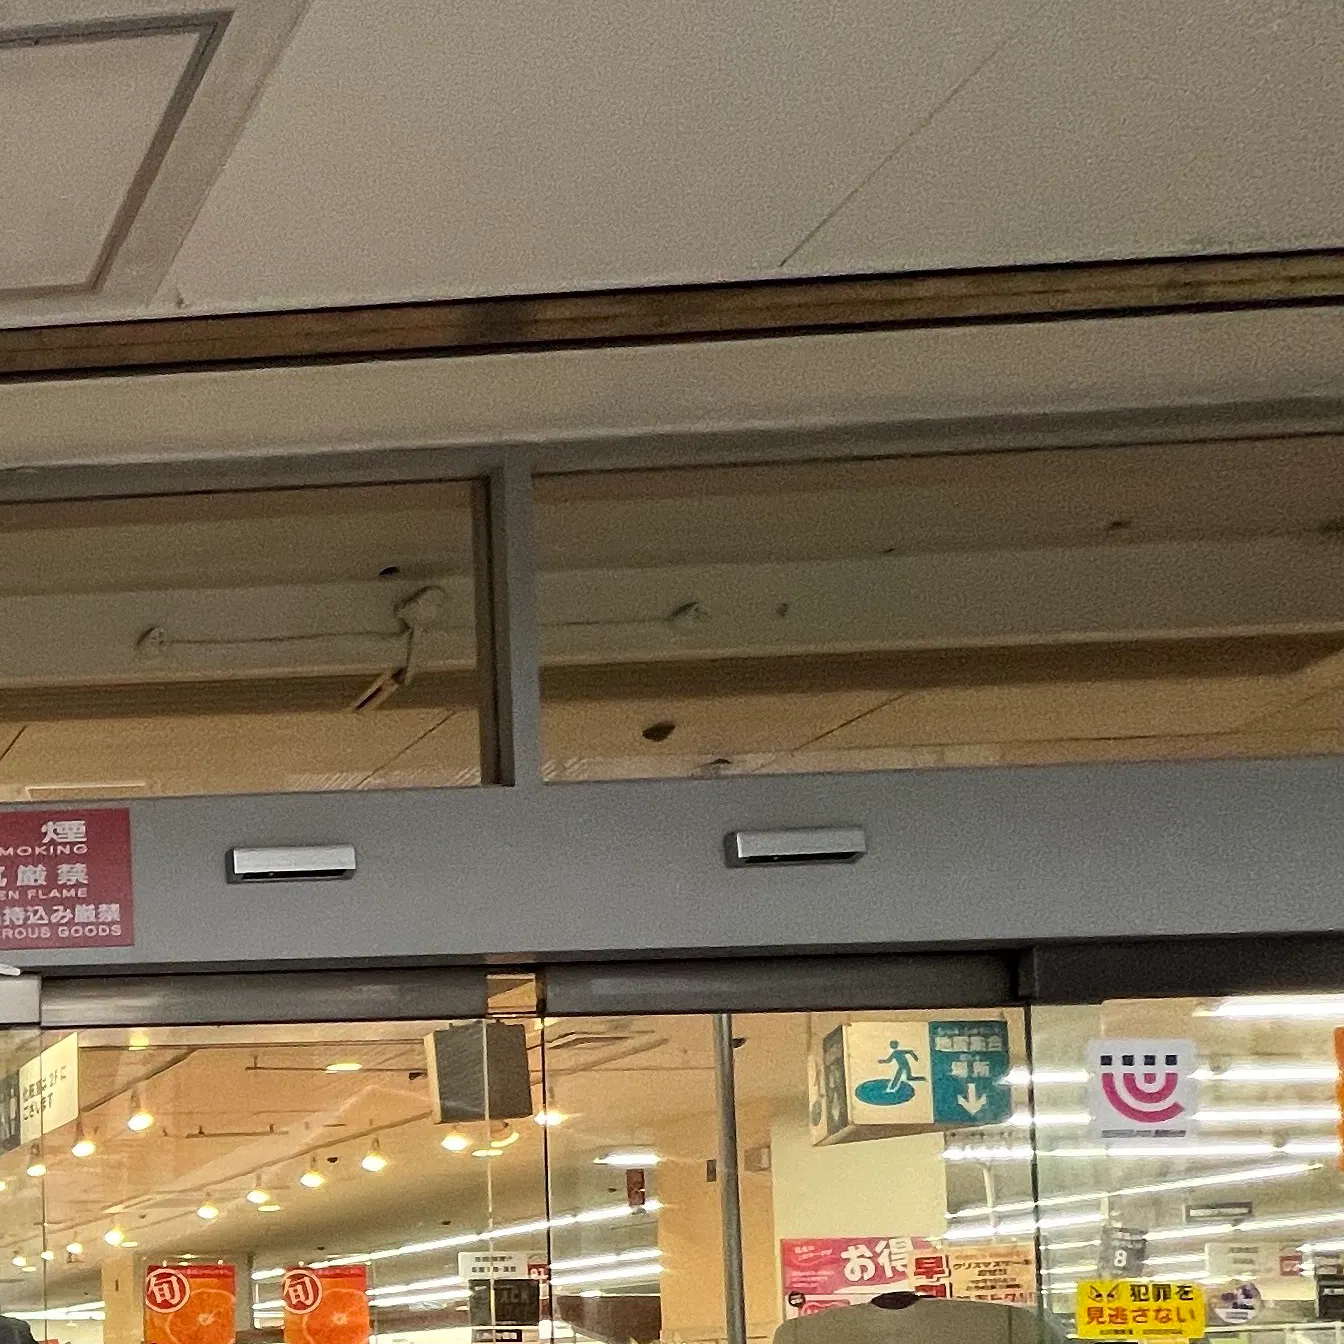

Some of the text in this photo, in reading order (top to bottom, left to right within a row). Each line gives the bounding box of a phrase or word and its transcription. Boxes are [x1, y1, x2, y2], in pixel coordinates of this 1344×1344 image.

[27, 887, 88, 899] FLAME
[58, 924, 122, 938] GOODS
[1114, 1250, 1127, 1267] 8
[148, 1277, 181, 1305] 旬
[285, 1277, 316, 1306] 旬
[1130, 1284, 1194, 1302] 犯罪を
[1087, 1306, 1197, 1325] 見逃さない
